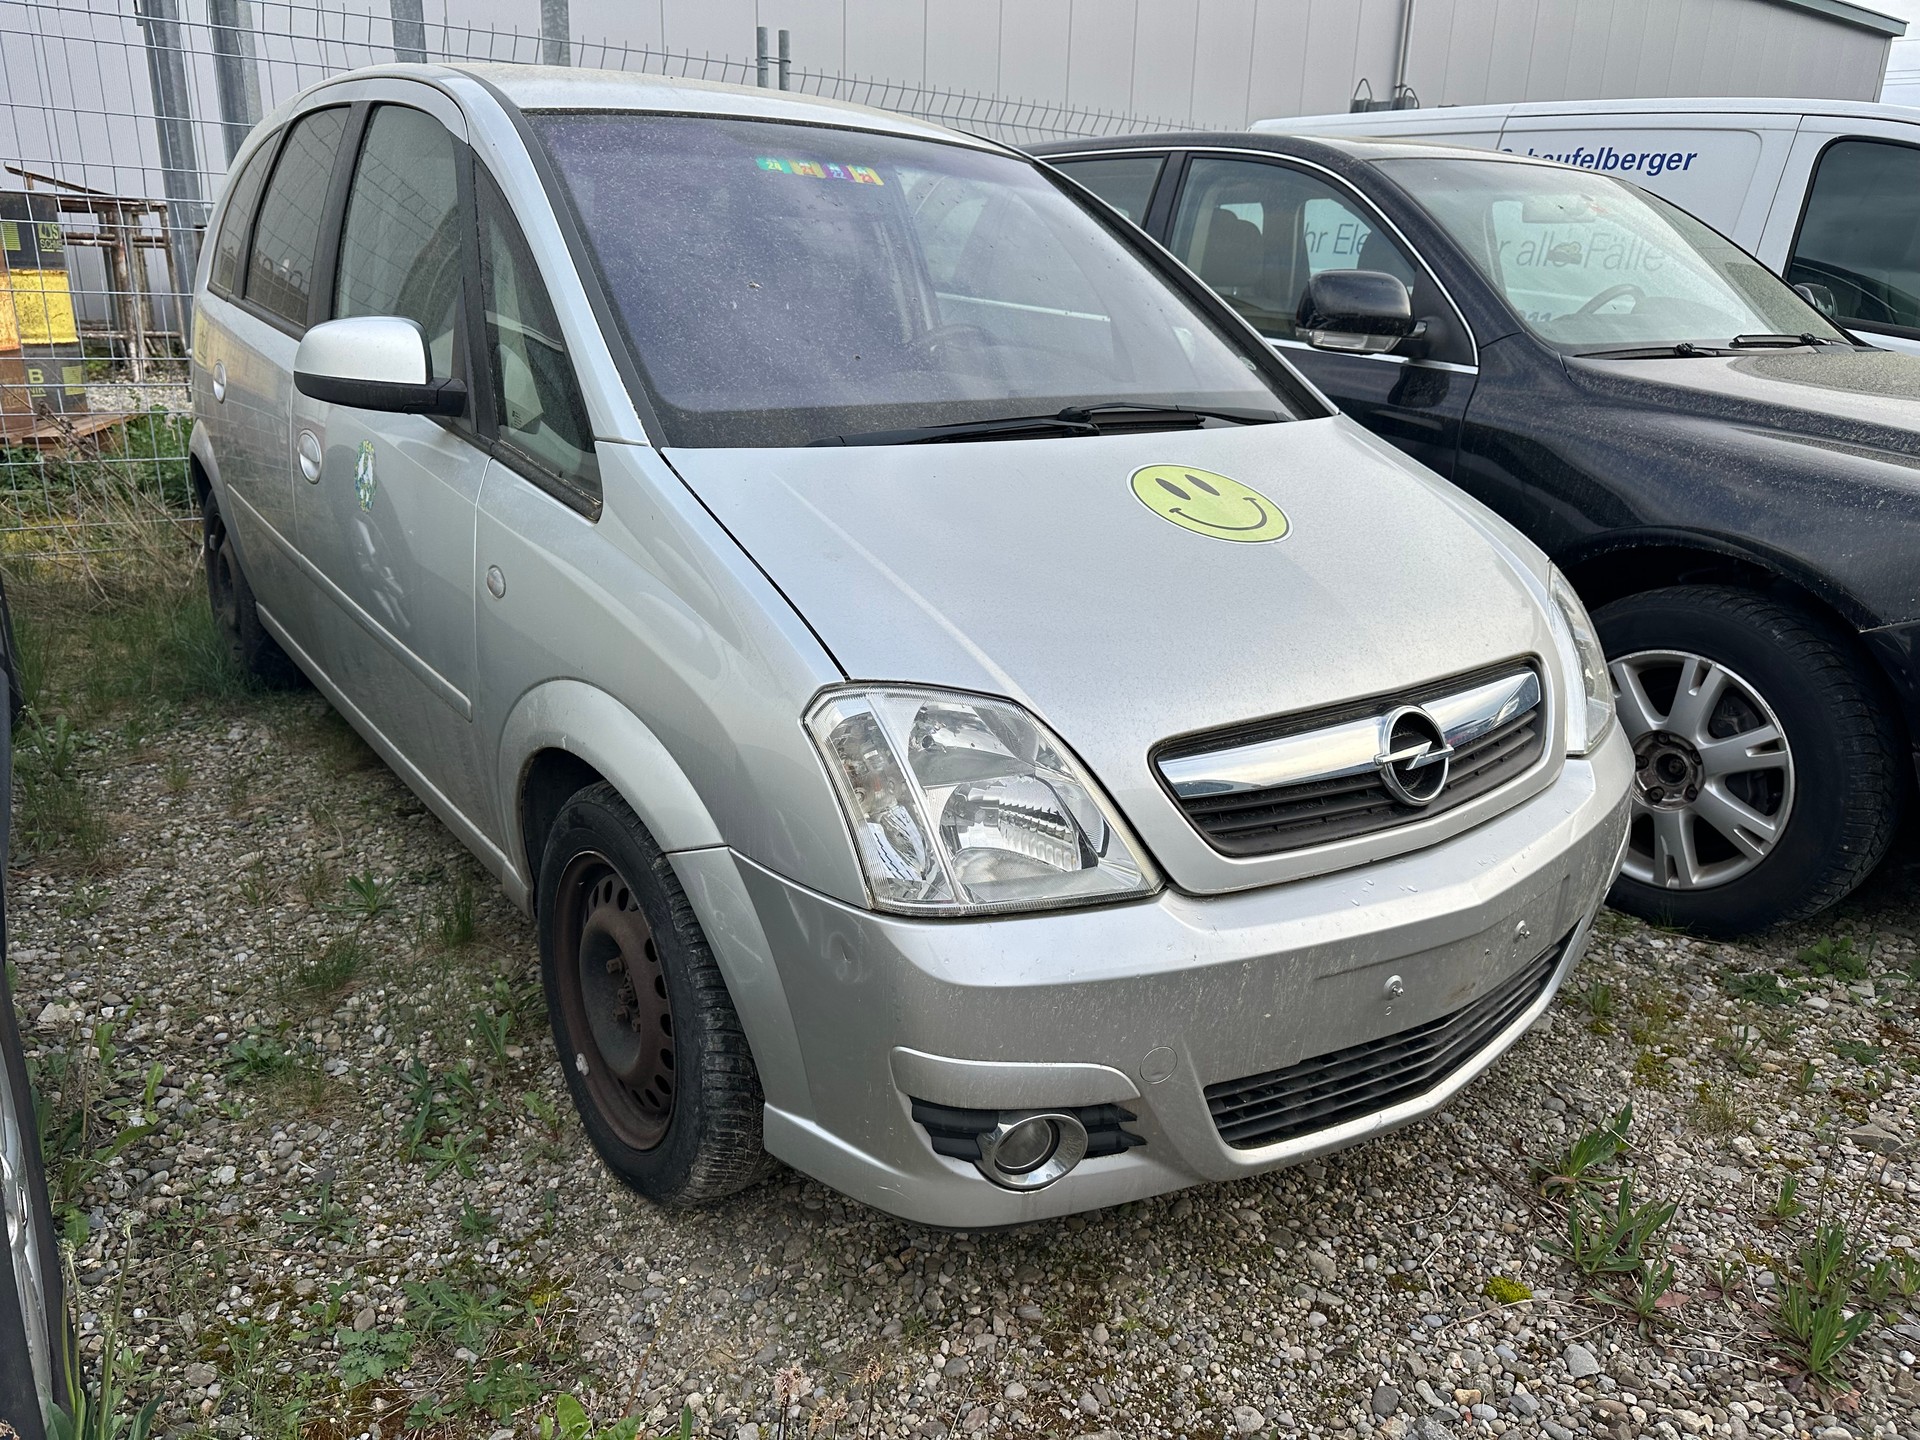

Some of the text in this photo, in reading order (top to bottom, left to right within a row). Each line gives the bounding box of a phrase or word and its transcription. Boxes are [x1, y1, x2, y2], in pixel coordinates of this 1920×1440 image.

[1501, 147, 1698, 176] ufelberger
[1583, 233, 1665, 271] Fälle
[28, 368, 44, 384] B
